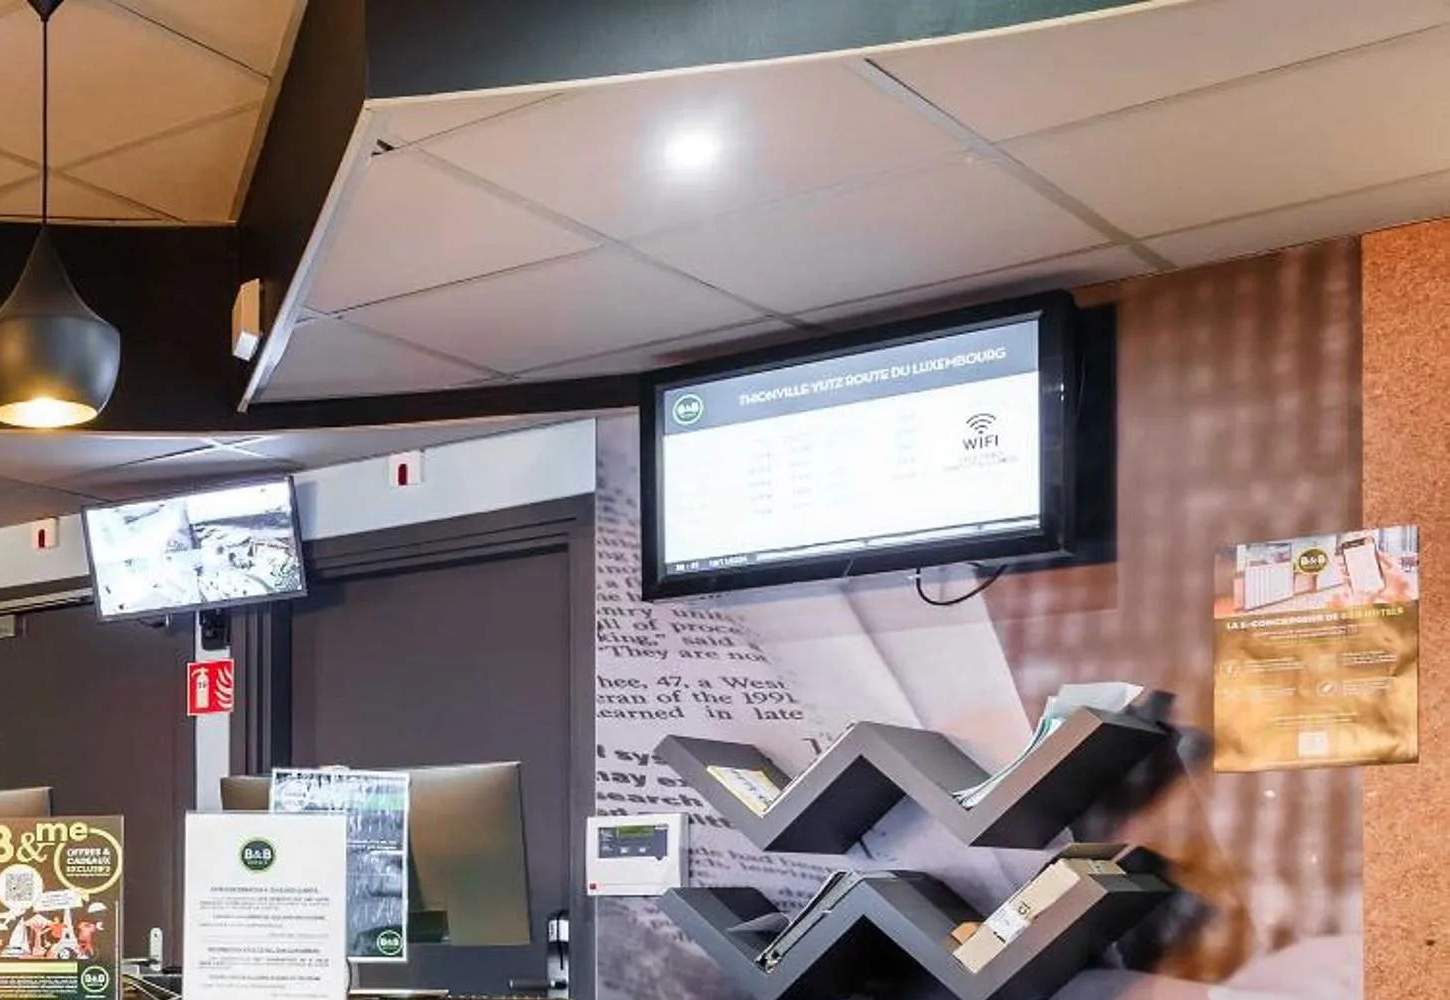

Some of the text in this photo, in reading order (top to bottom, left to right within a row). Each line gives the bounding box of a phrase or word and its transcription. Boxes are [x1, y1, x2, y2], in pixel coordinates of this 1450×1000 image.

[738, 347, 1008, 406] THIONVILLE YUTZ ROUTE DU LUXEMBOURG
[962, 434, 999, 450] WIFI
[632, 618, 658, 631] of
[681, 636, 735, 647] said
[677, 650, 720, 659] are
[655, 675, 690, 690] 47,
[697, 679, 714, 689] a
[718, 675, 788, 690] West
[656, 690, 682, 704] of
[692, 691, 734, 705] the
[742, 691, 799, 705] 1991
[596, 705, 805, 721] earned in late
[244, 847, 272, 859] B&B
